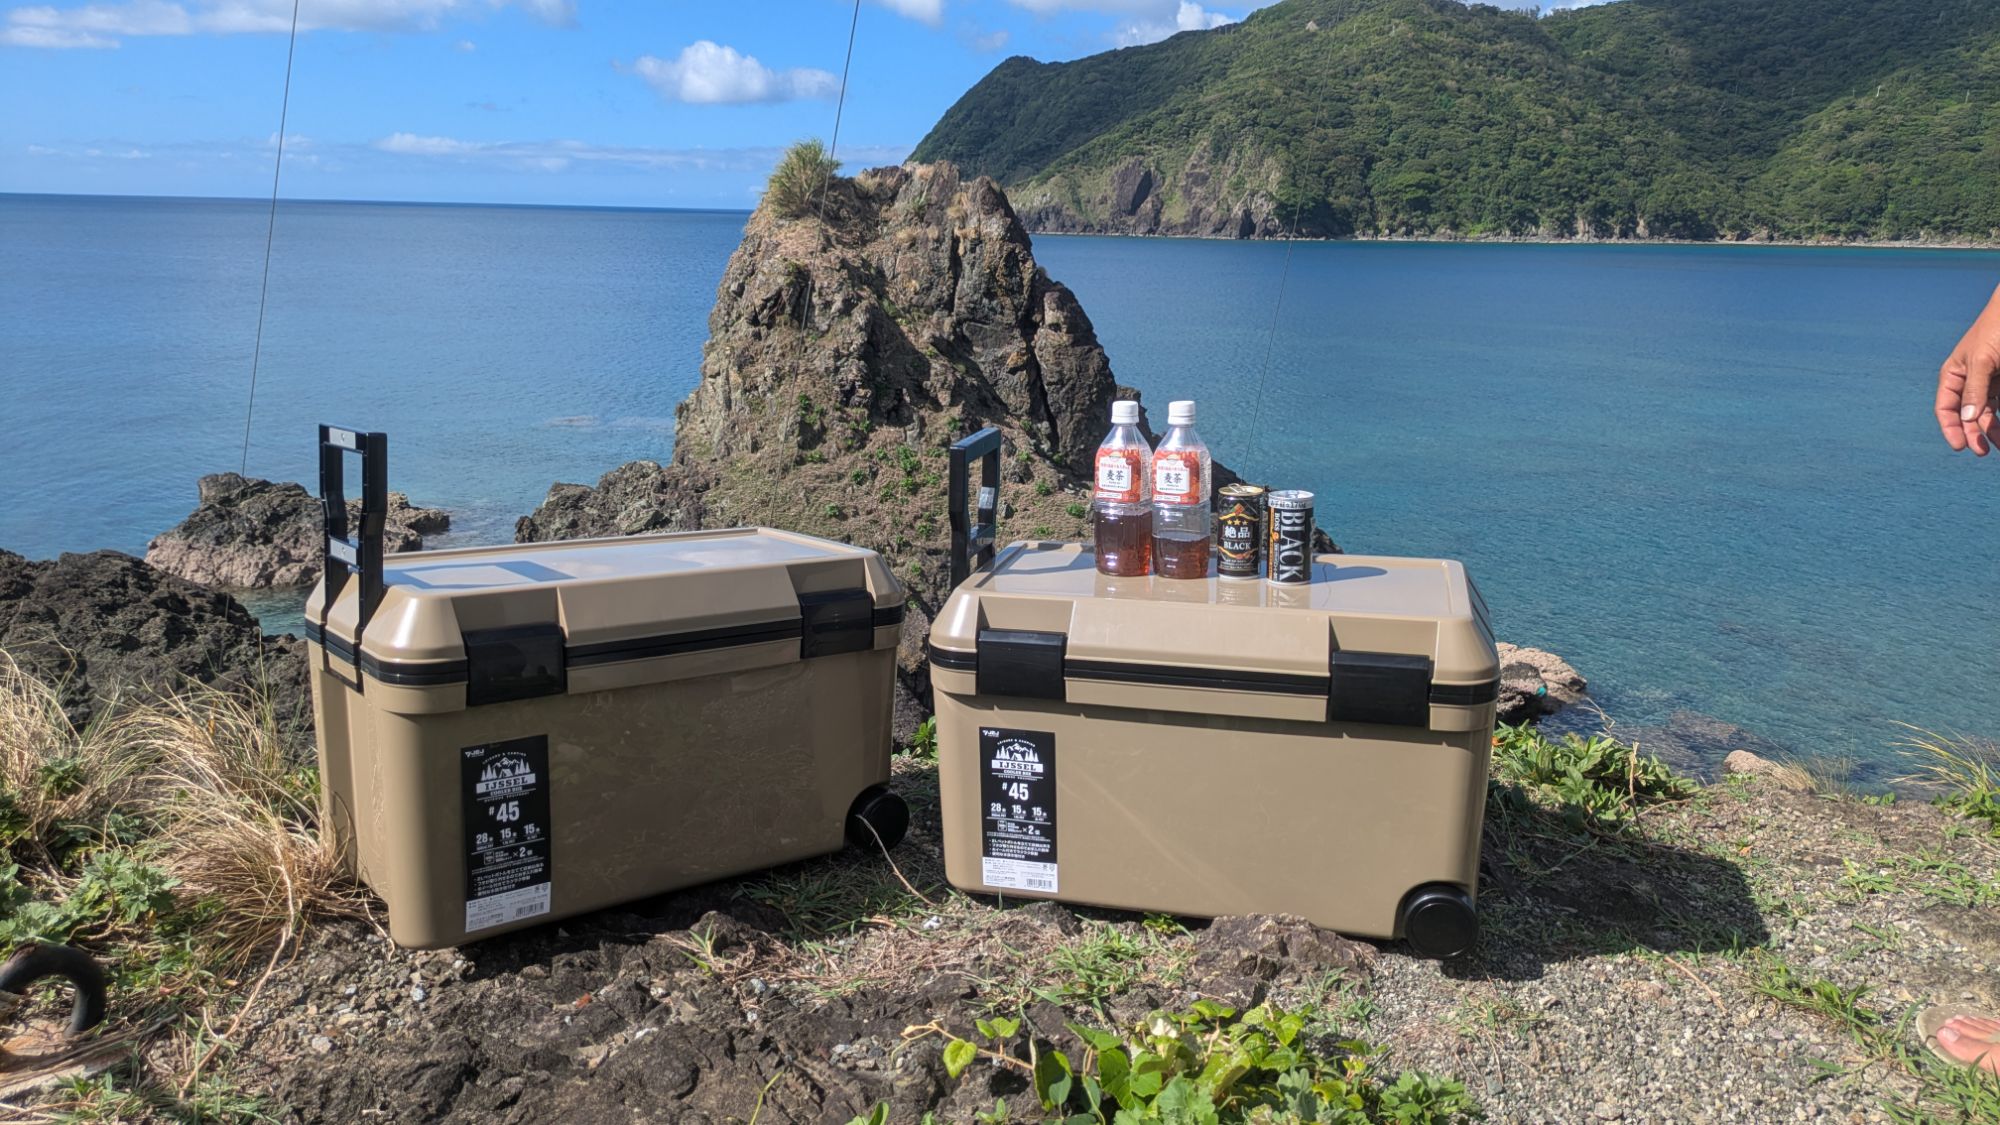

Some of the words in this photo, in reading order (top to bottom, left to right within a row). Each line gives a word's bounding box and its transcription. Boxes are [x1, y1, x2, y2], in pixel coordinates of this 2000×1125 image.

[1106, 469, 1124, 481] 麦茶
[1164, 472, 1183, 484] 麦茶
[1224, 526, 1251, 539] 絶品
[1223, 541, 1252, 550] BLACK
[1279, 510, 1306, 582] BLACK
[999, 761, 1037, 771] IJSSEL
[485, 776, 528, 790] IJSSEL
